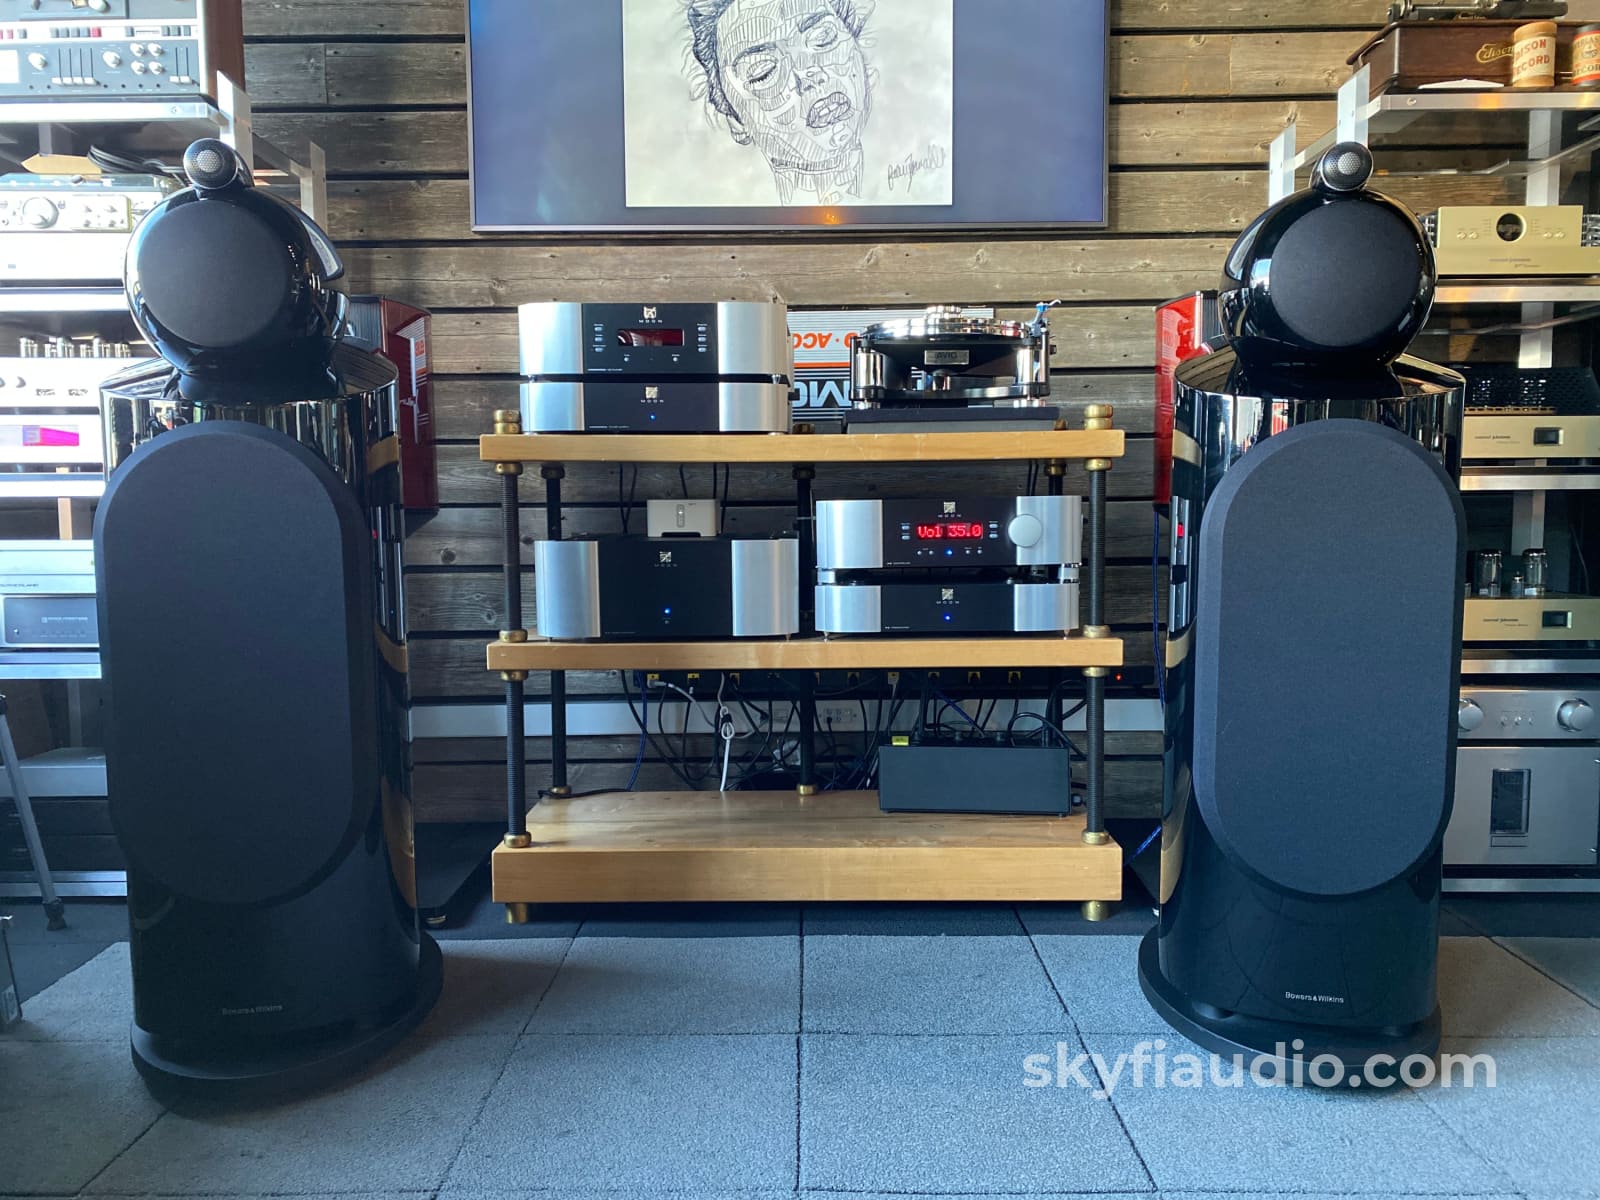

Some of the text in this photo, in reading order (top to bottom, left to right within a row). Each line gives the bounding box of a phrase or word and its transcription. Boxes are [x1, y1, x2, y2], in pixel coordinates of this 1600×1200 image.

[1515, 39, 1547, 61] DISON
[917, 524, 983, 538] Vol 35.0
